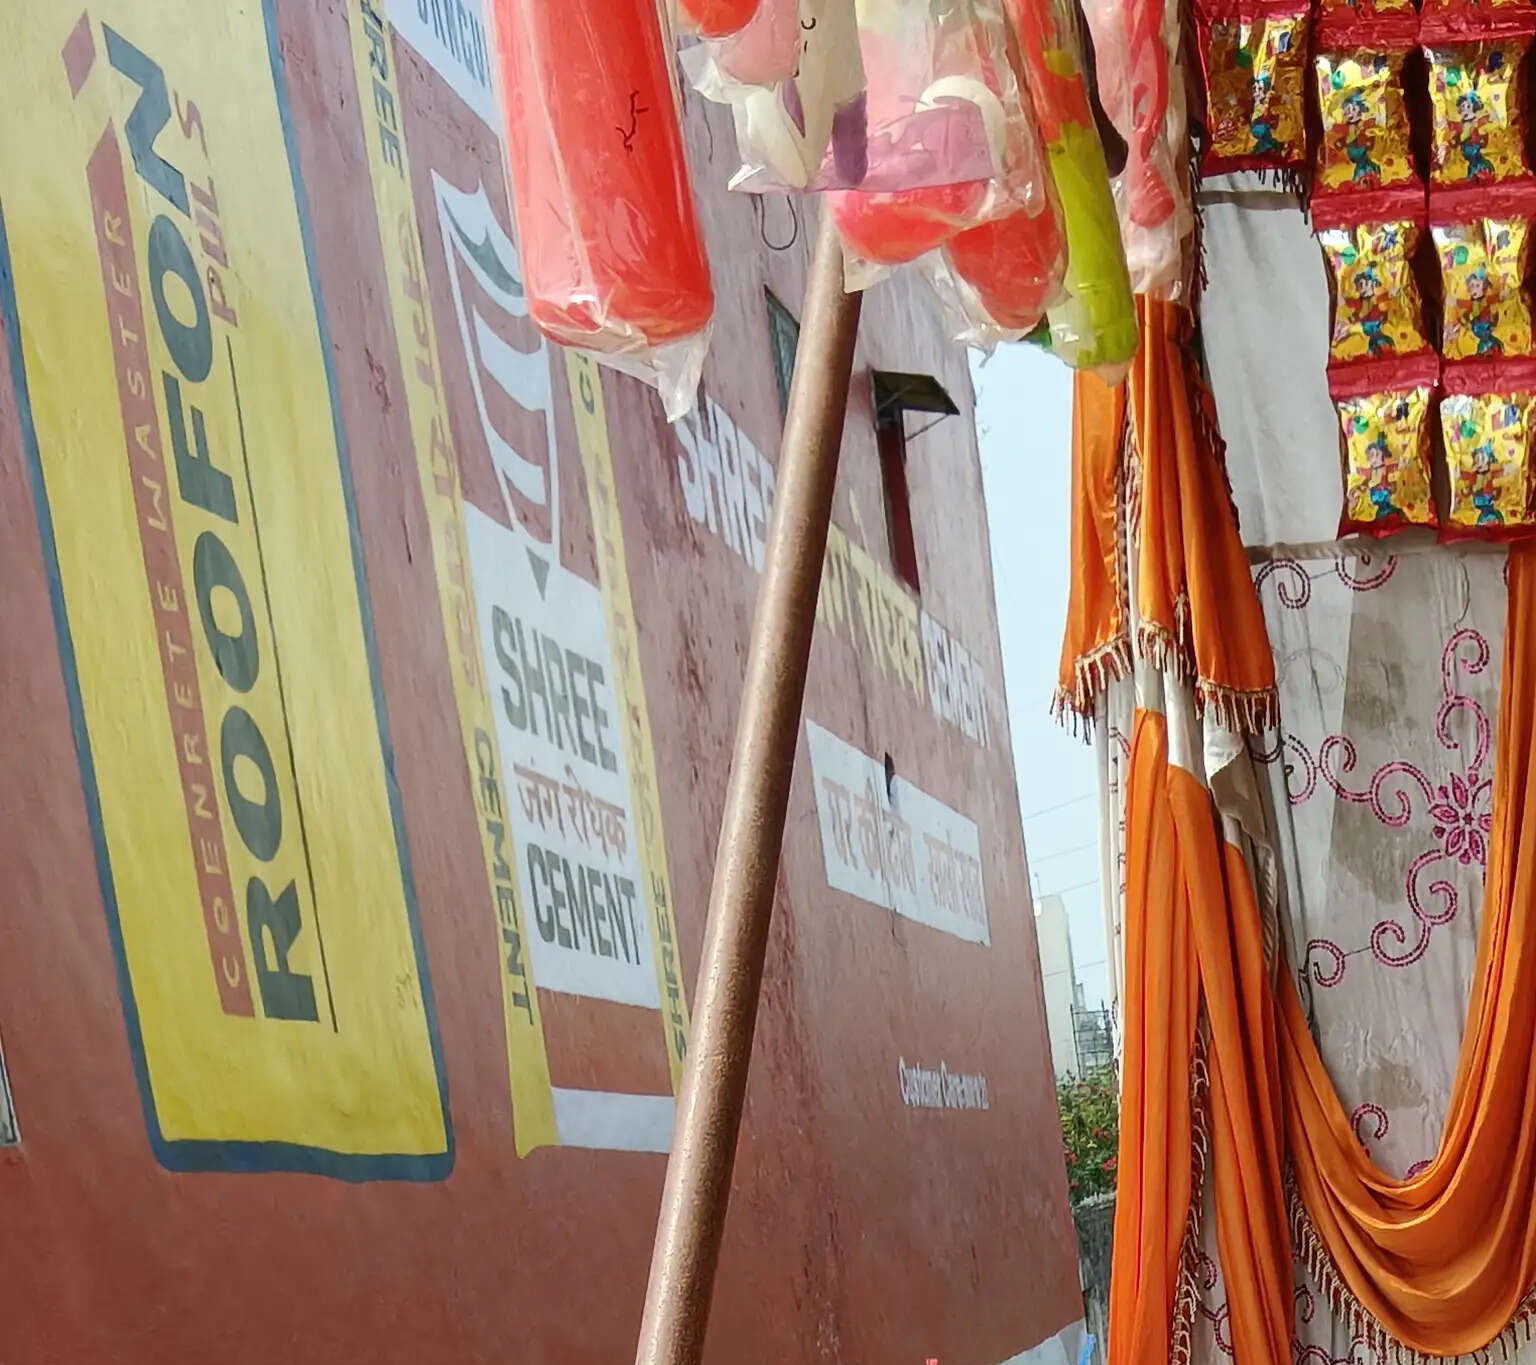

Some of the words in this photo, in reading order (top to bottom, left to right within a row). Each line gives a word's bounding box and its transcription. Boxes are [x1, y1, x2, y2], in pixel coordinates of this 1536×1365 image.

[104, 215, 168, 531] WASTER
[101, 21, 318, 1022] ROOFON
[491, 604, 619, 774] SHREE
[473, 726, 533, 1027] CEMENT
[526, 840, 641, 967] CEMENT
[651, 871, 688, 1066] SHREE
